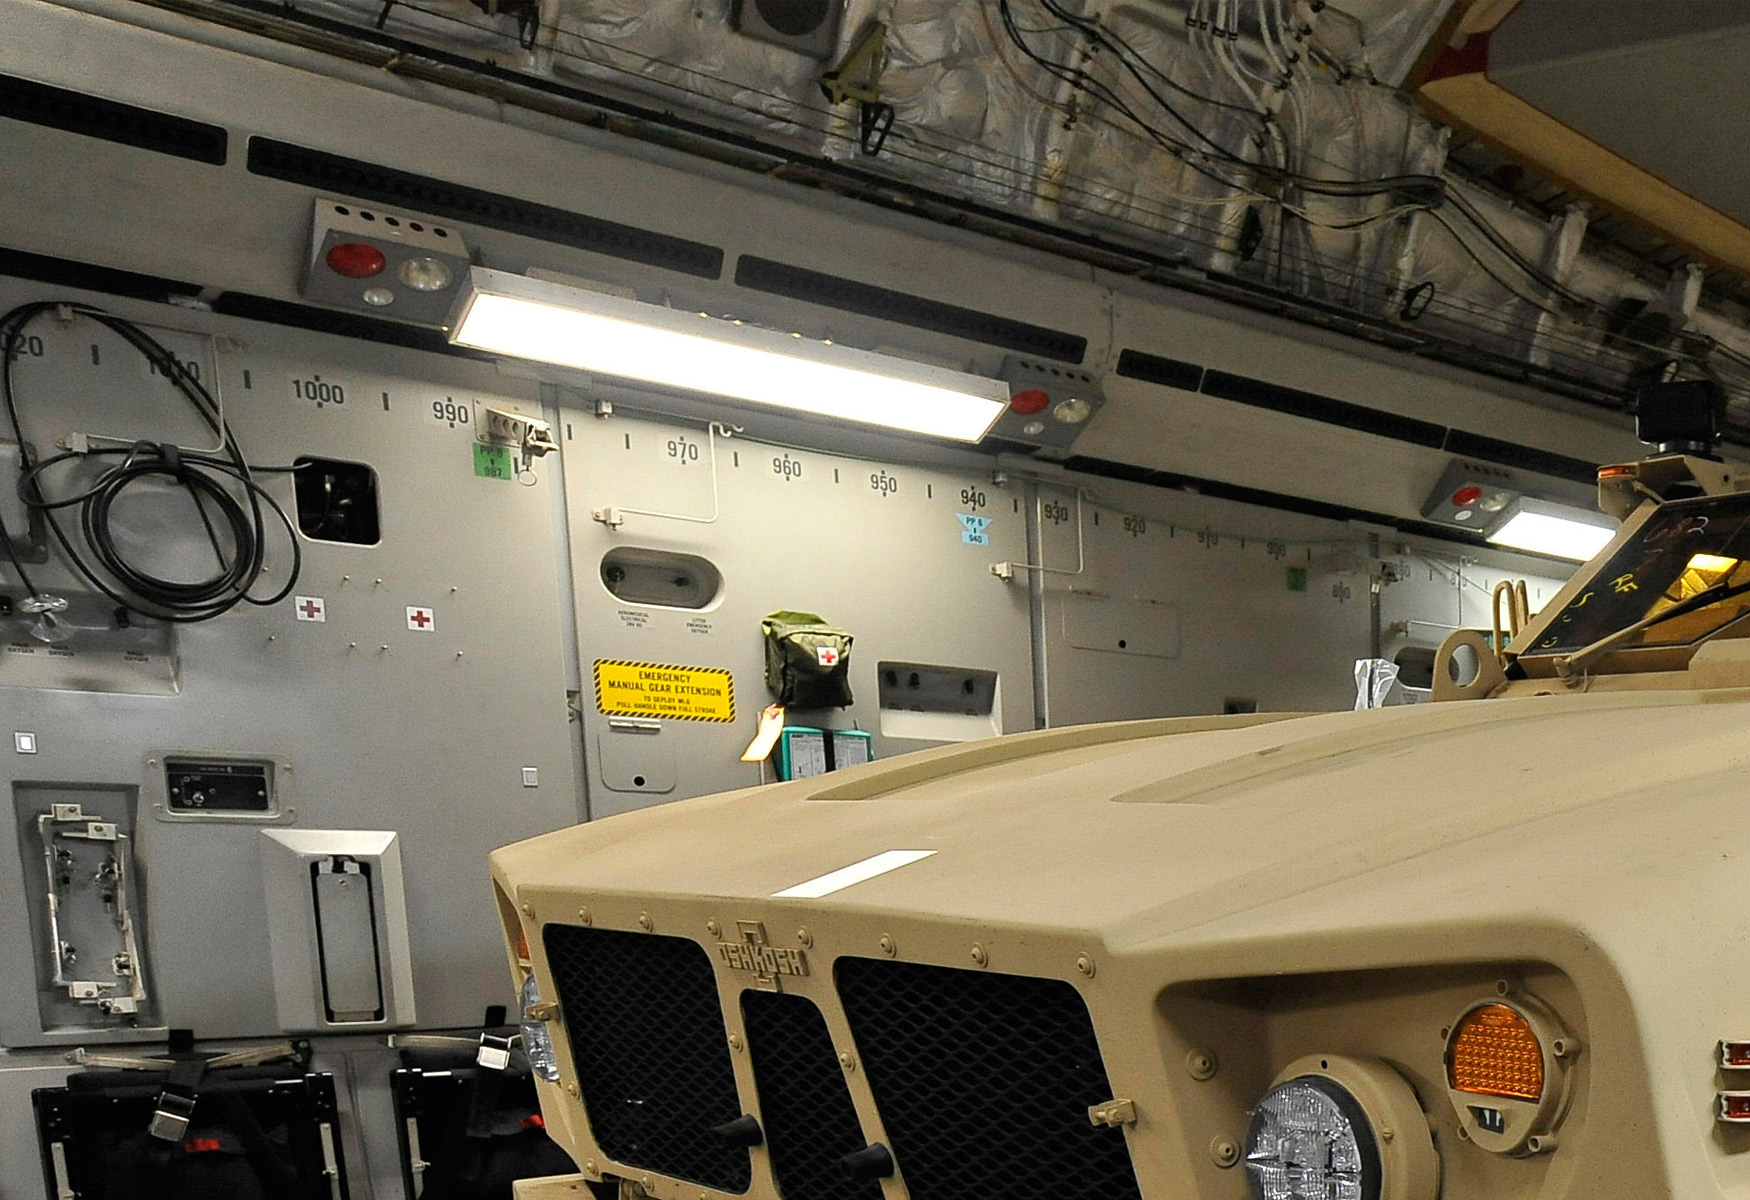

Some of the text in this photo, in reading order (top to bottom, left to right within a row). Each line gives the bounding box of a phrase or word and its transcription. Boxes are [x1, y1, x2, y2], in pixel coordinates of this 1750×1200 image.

[292, 378, 345, 405] 1000
[432, 400, 468, 424] 990
[667, 440, 699, 461] 970
[772, 457, 802, 477] 960
[870, 473, 897, 493] 950
[961, 489, 986, 507] 940
[1044, 503, 1068, 522] 930
[1123, 516, 1146, 534] 920
[639, 671, 691, 684] EMERGENCY
[608, 680, 721, 697] MANUAL GEAR EXTENSION
[634, 702, 656, 710] HANDLE
[717, 942, 811, 977] OSHKOSH
